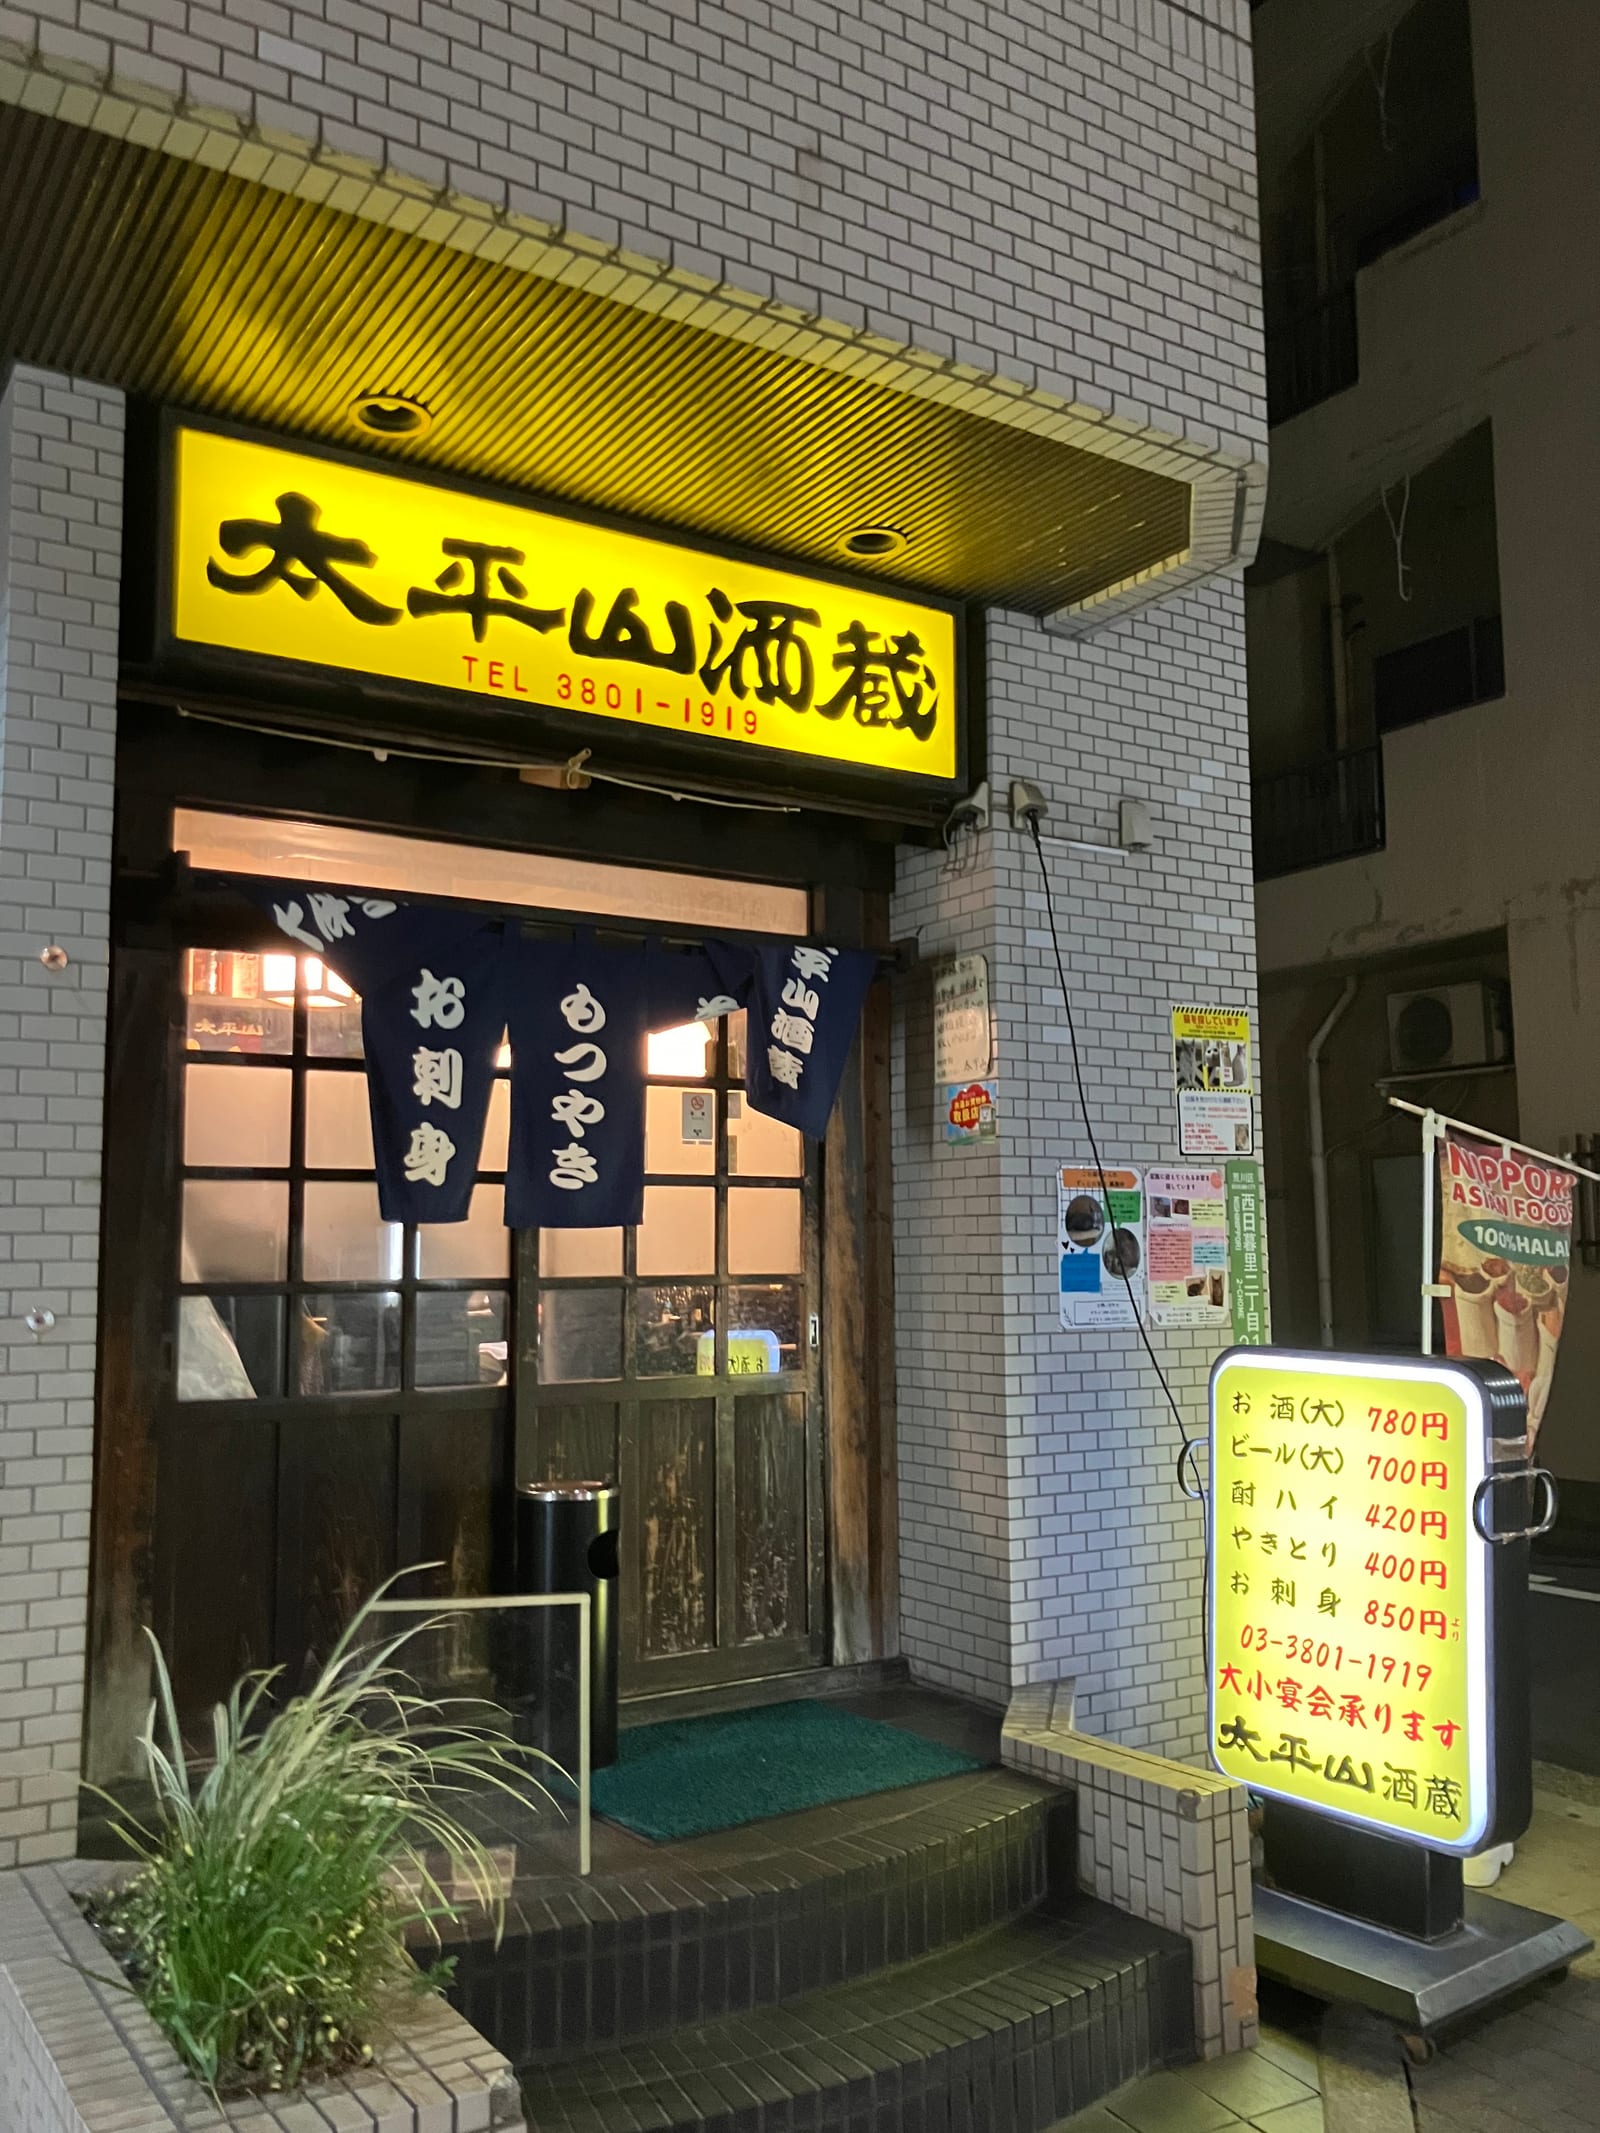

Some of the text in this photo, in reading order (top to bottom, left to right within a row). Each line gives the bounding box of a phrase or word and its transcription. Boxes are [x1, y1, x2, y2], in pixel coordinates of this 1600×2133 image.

[206, 491, 940, 743] 太平山酒蔵
[462, 655, 760, 737] TEL 3801-1919
[404, 968, 466, 1188] お刺身
[550, 982, 607, 1190] もつやき
[1451, 1182, 1508, 1217] ASIAN
[1241, 1193, 1259, 1332] 西日暮里二丁目
[1236, 1278, 1245, 1319] 2-CHOME
[1232, 1391, 1448, 1441] お酒(大) 780円
[1231, 1434, 1447, 1490] ビール(大) 700円
[1231, 1480, 1447, 1540] 酎ハイ 420円
[1231, 1526, 1447, 1590] やきとり 400円
[1230, 1571, 1341, 1618] お刺身
[1364, 1600, 1447, 1640] 850円
[1240, 1624, 1432, 1691] 03-3801-1919
[1218, 1662, 1462, 1749] 大小宴会承ります
[1218, 1715, 1462, 1822] 太平山酒蔵
